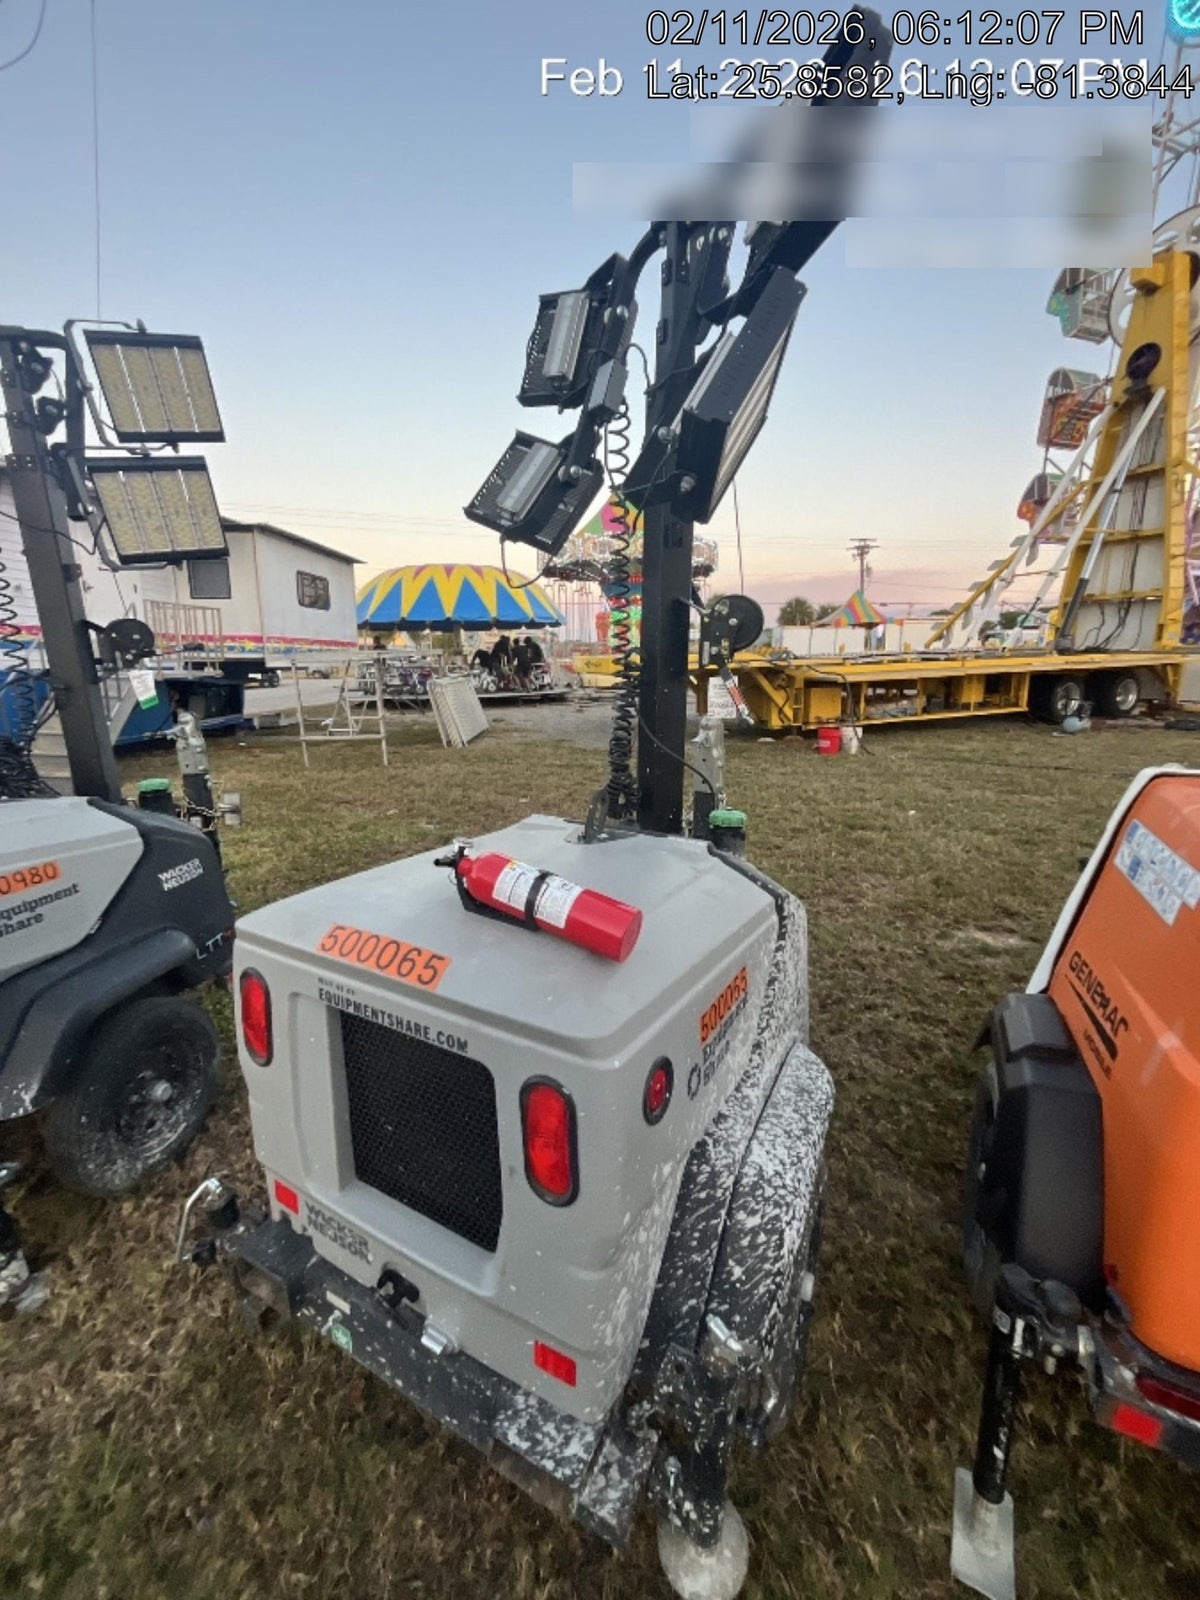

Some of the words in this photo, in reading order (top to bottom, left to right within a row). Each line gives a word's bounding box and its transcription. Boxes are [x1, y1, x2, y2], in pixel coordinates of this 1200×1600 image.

[321, 925, 446, 987] 500065
[318, 987, 469, 1054] EQUIPMENTSHARE.COM
[1069, 950, 1129, 1038] GENERAC
